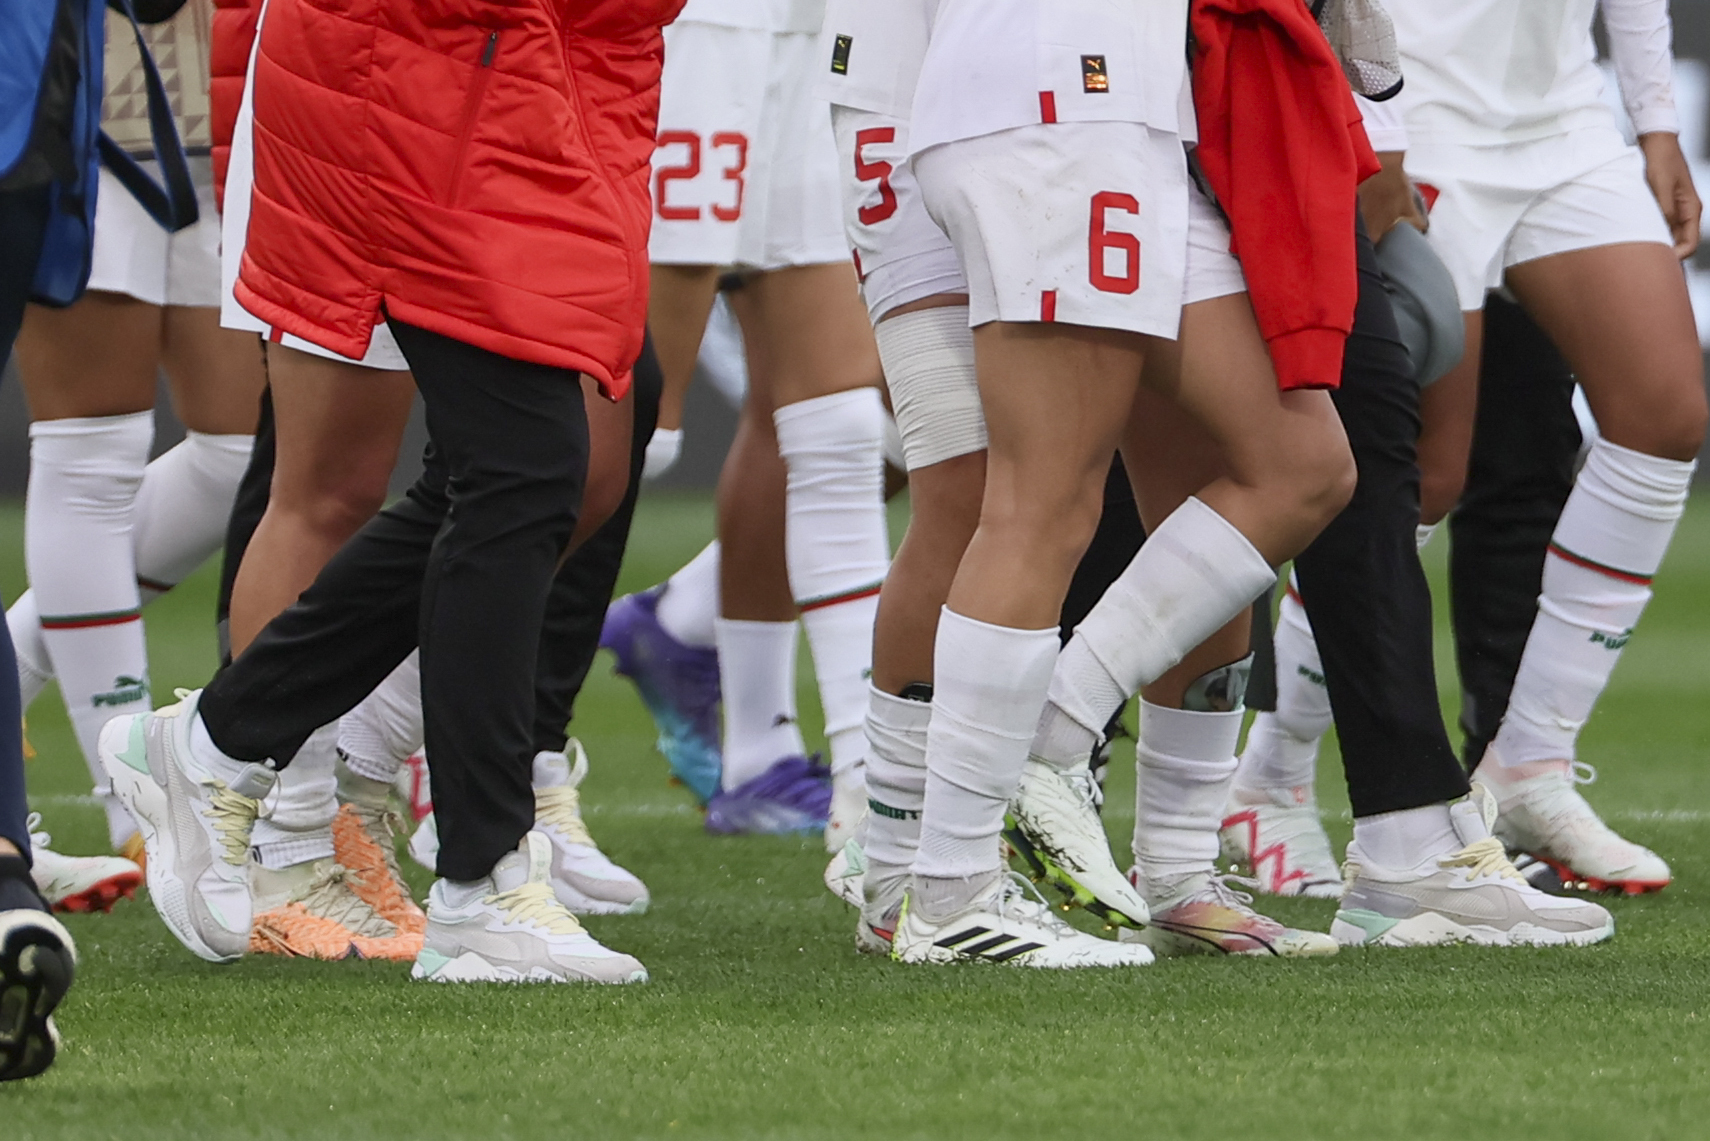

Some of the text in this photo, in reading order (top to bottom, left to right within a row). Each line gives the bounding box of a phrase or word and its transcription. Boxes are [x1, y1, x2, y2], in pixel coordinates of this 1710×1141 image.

[655, 129, 748, 222] 23
[854, 127, 898, 226] 5
[1088, 190, 1141, 295] 6
